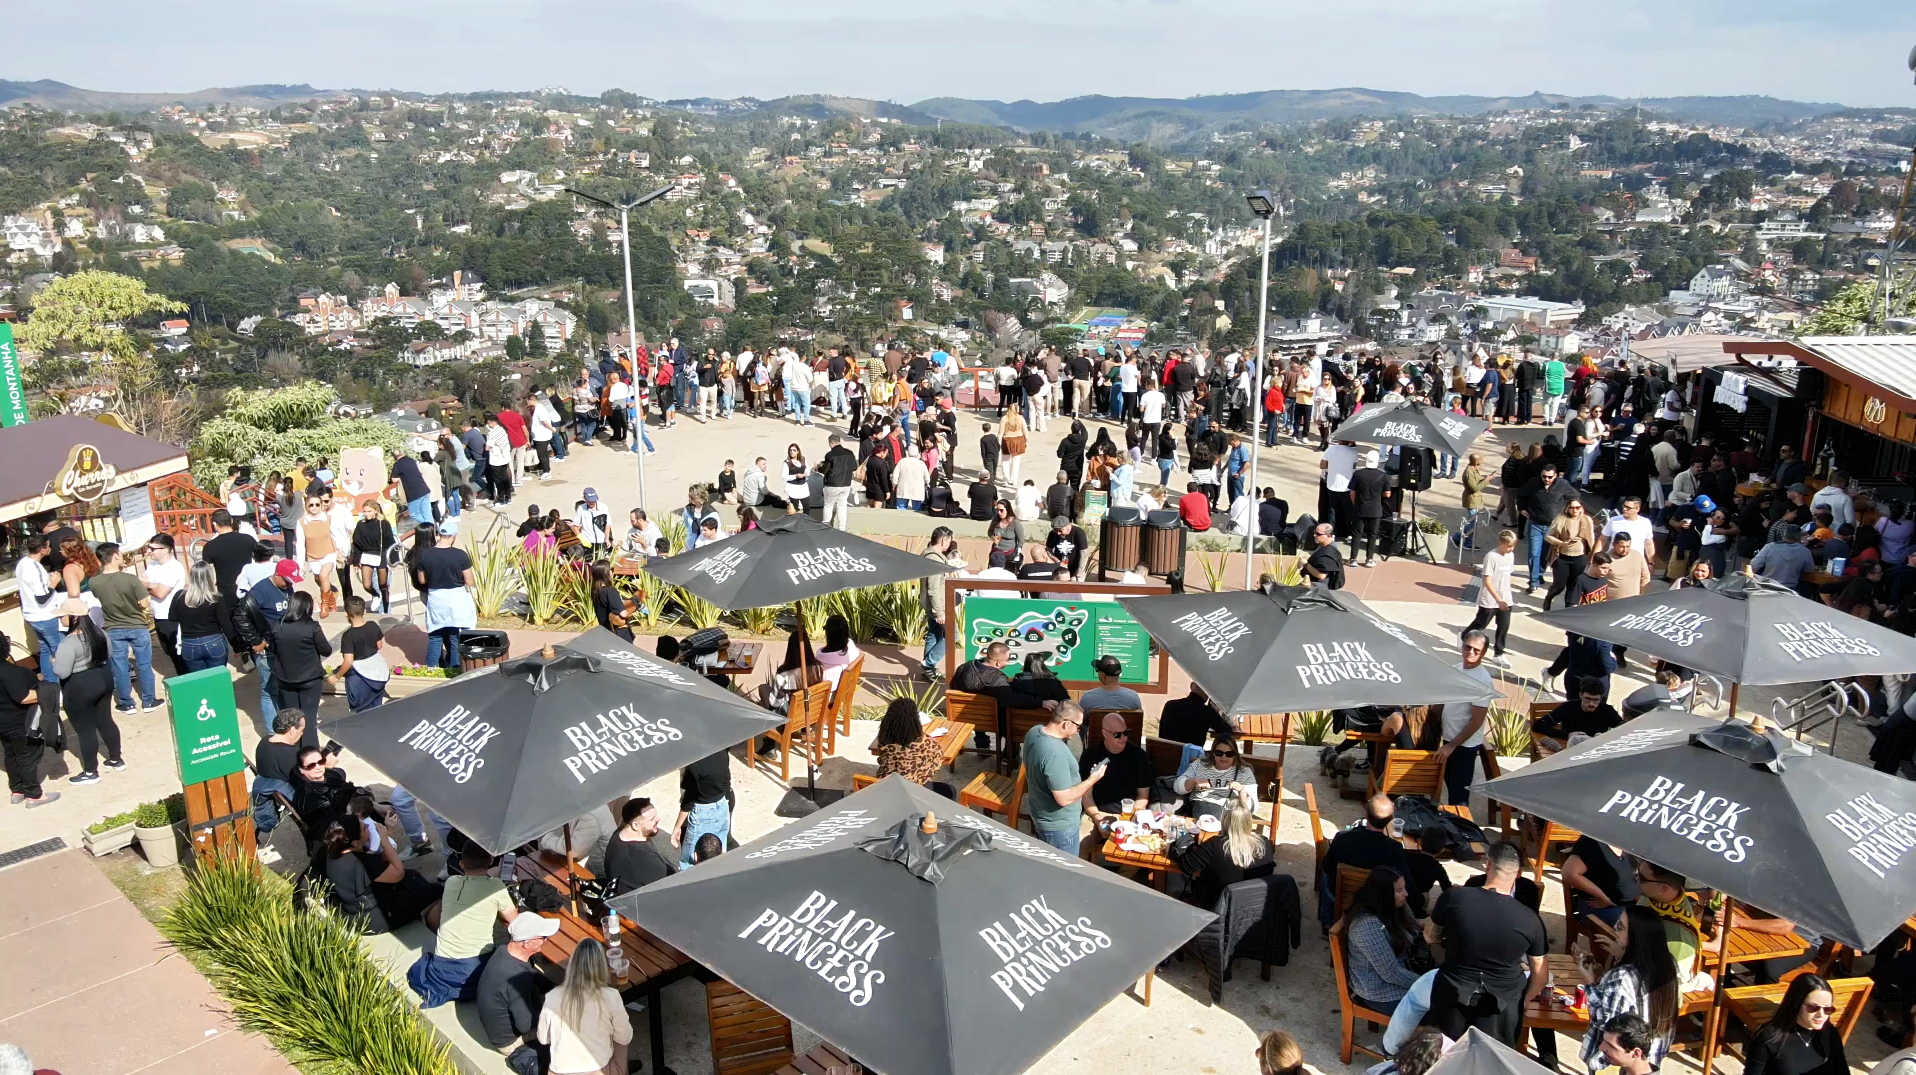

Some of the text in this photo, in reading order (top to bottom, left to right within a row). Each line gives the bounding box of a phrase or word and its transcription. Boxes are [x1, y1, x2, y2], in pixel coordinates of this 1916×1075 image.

[1, 342, 22, 409] MONTANHA
[1384, 421, 1418, 436] BLACK
[62, 465, 116, 495] Churros
[713, 546, 750, 567] BLACK
[791, 546, 855, 568] BLACK
[1204, 606, 1252, 643] BLACK
[1644, 604, 1712, 630] BLACK
[1774, 621, 1847, 642] BLACK
[1302, 641, 1376, 665] BLACK
[199, 734, 220, 744] Rota
[435, 704, 501, 754] BLACK
[563, 703, 649, 751] BLACK
[1642, 775, 1751, 831] BLACK
[1825, 792, 1899, 842] BLACK
[789, 889, 896, 962] BLACK
[978, 895, 1069, 964] BLACK
